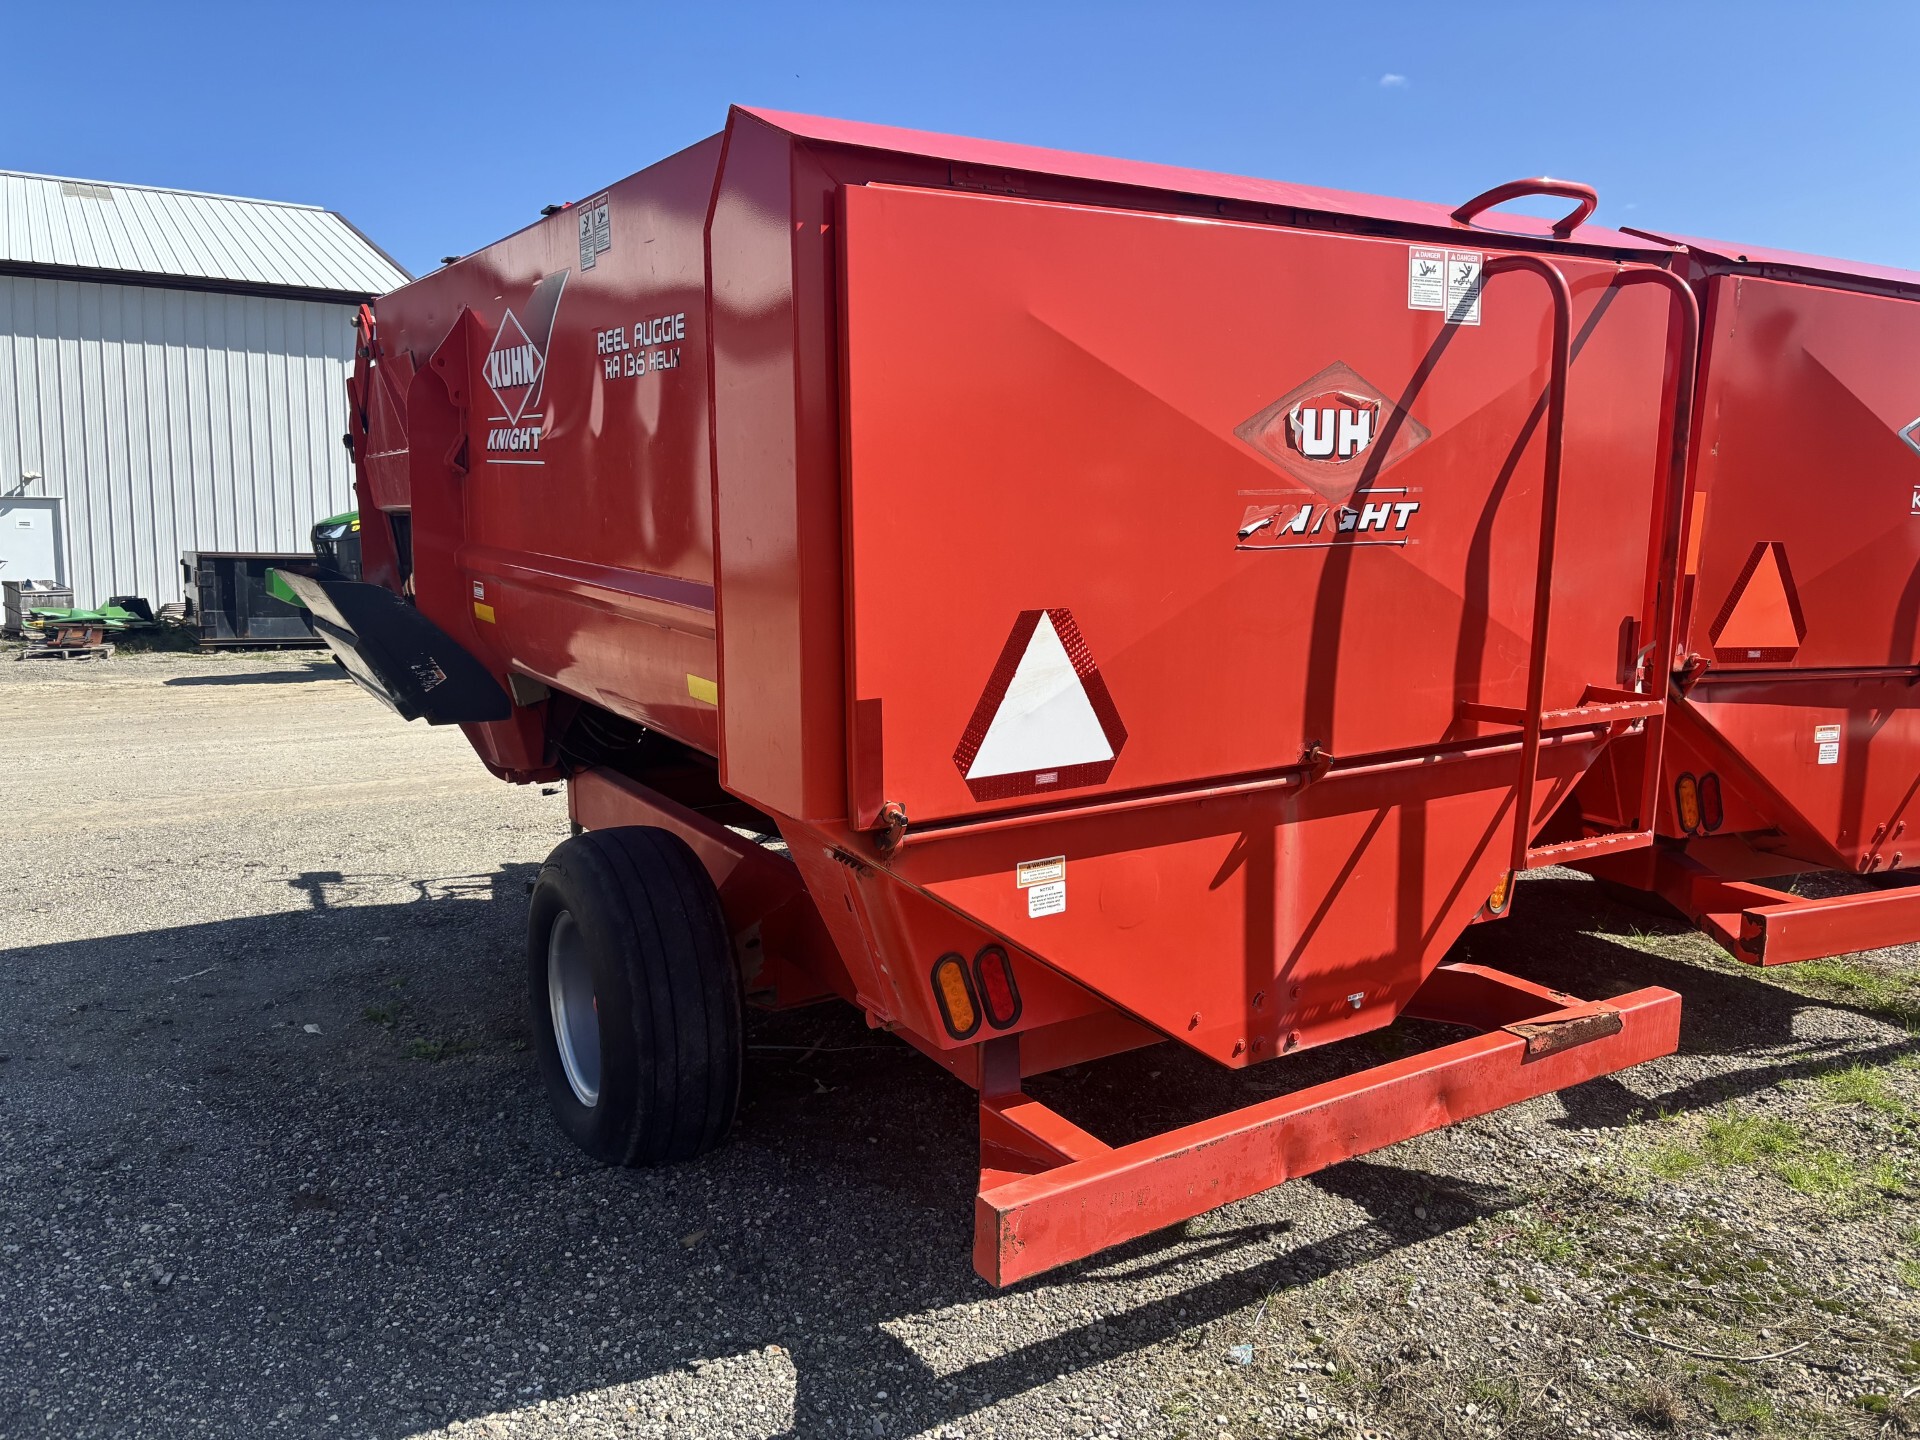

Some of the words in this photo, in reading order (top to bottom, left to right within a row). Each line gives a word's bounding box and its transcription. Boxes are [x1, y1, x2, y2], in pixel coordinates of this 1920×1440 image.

[597, 327, 630, 356] REEL
[634, 313, 685, 348] AUGGIE
[490, 343, 534, 388] KUHN
[603, 357, 621, 380] RA
[623, 350, 646, 377] 136
[648, 347, 680, 372] HELIX
[486, 426, 542, 453] KNIGHT
